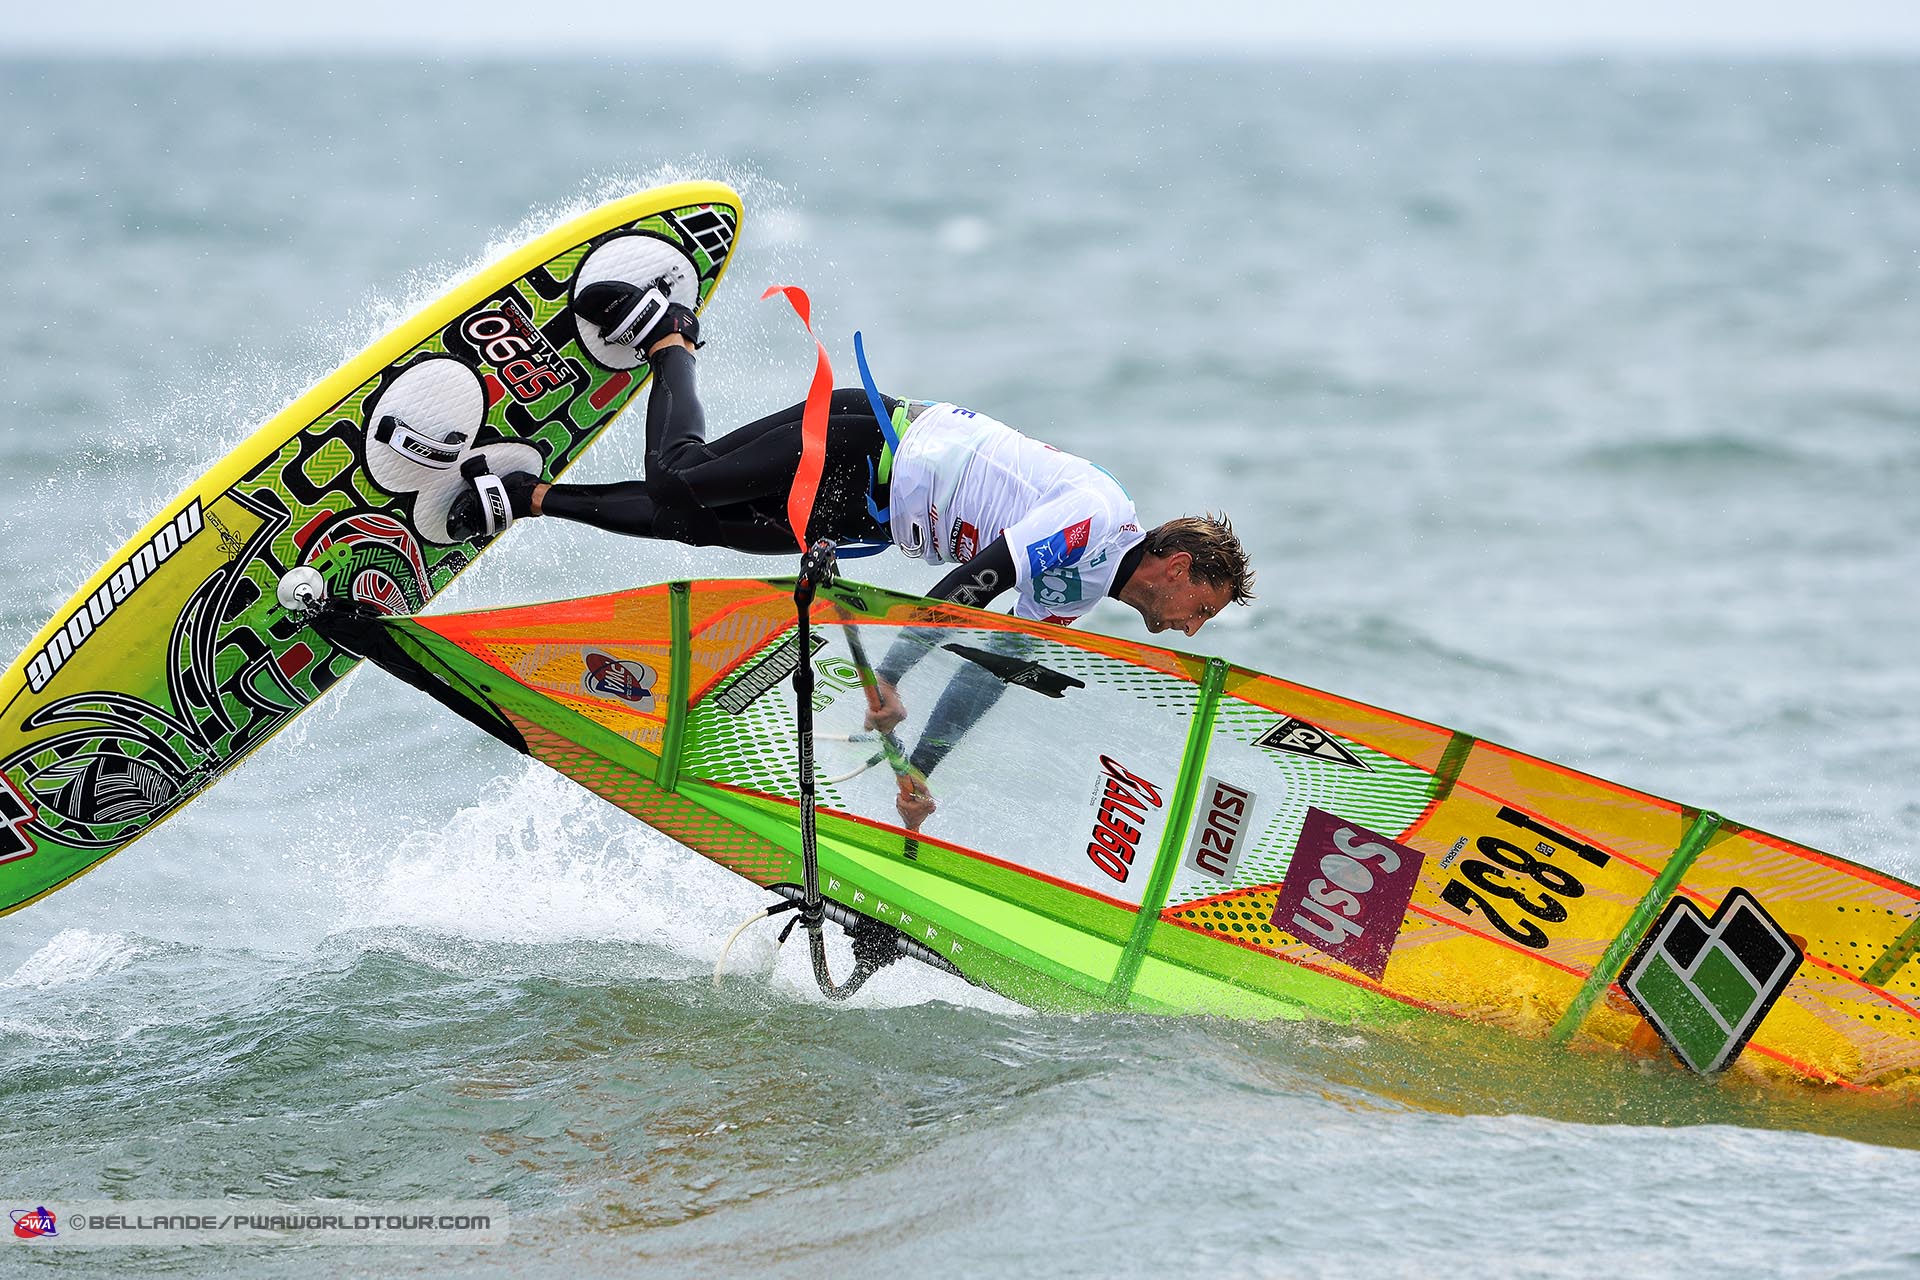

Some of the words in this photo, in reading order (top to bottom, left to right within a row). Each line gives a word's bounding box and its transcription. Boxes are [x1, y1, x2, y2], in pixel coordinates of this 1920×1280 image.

[505, 307, 532, 338] PRO
[527, 332, 570, 380] STYLE
[27, 497, 205, 693] novenove
[1269, 721, 1300, 745] SAILS
[1279, 728, 1322, 750] GA
[1195, 782, 1249, 877] ISUZU
[1439, 805, 1611, 949] 1832
